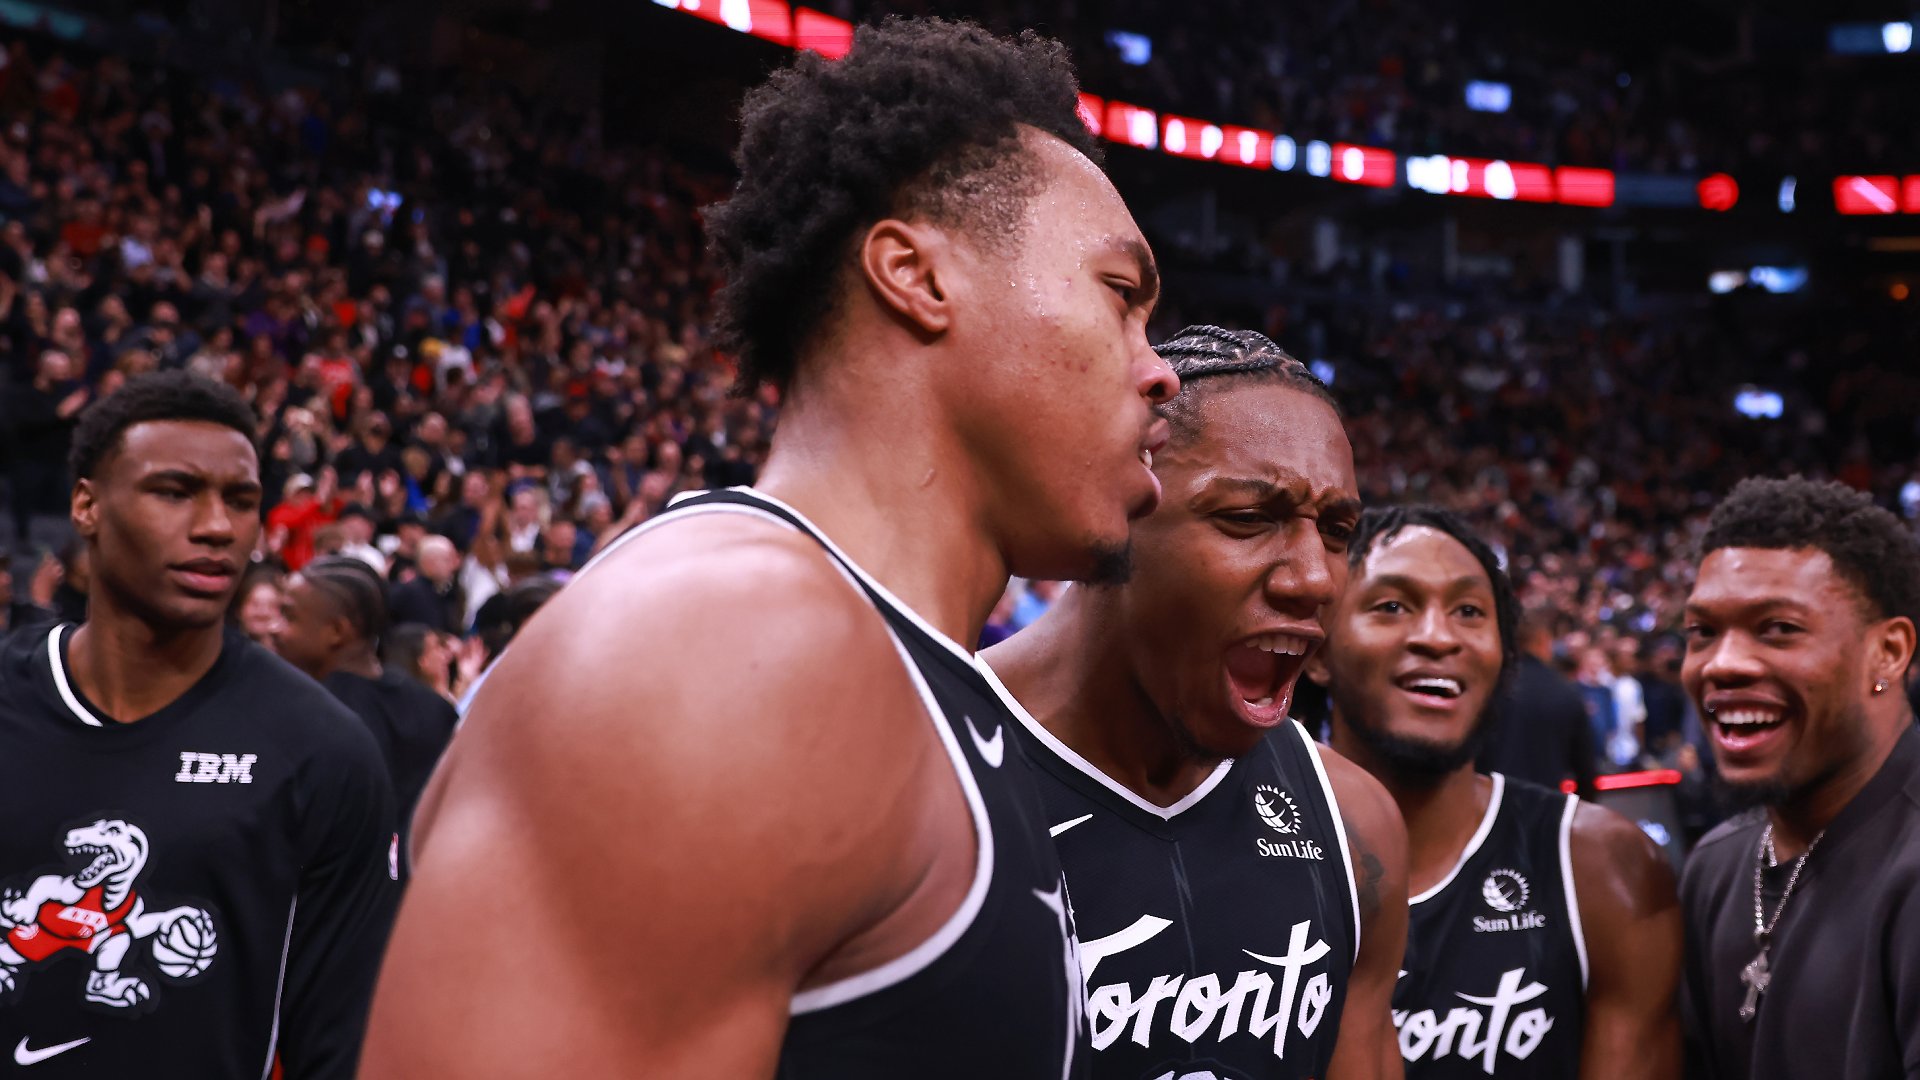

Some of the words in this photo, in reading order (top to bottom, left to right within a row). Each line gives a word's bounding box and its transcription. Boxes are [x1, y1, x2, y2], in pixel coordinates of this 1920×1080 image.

[175, 752, 257, 784] IBM
[1257, 839, 1291, 859] Sun
[1291, 840, 1323, 861] Life
[1473, 917, 1509, 933] Sun
[1513, 910, 1547, 931] Life
